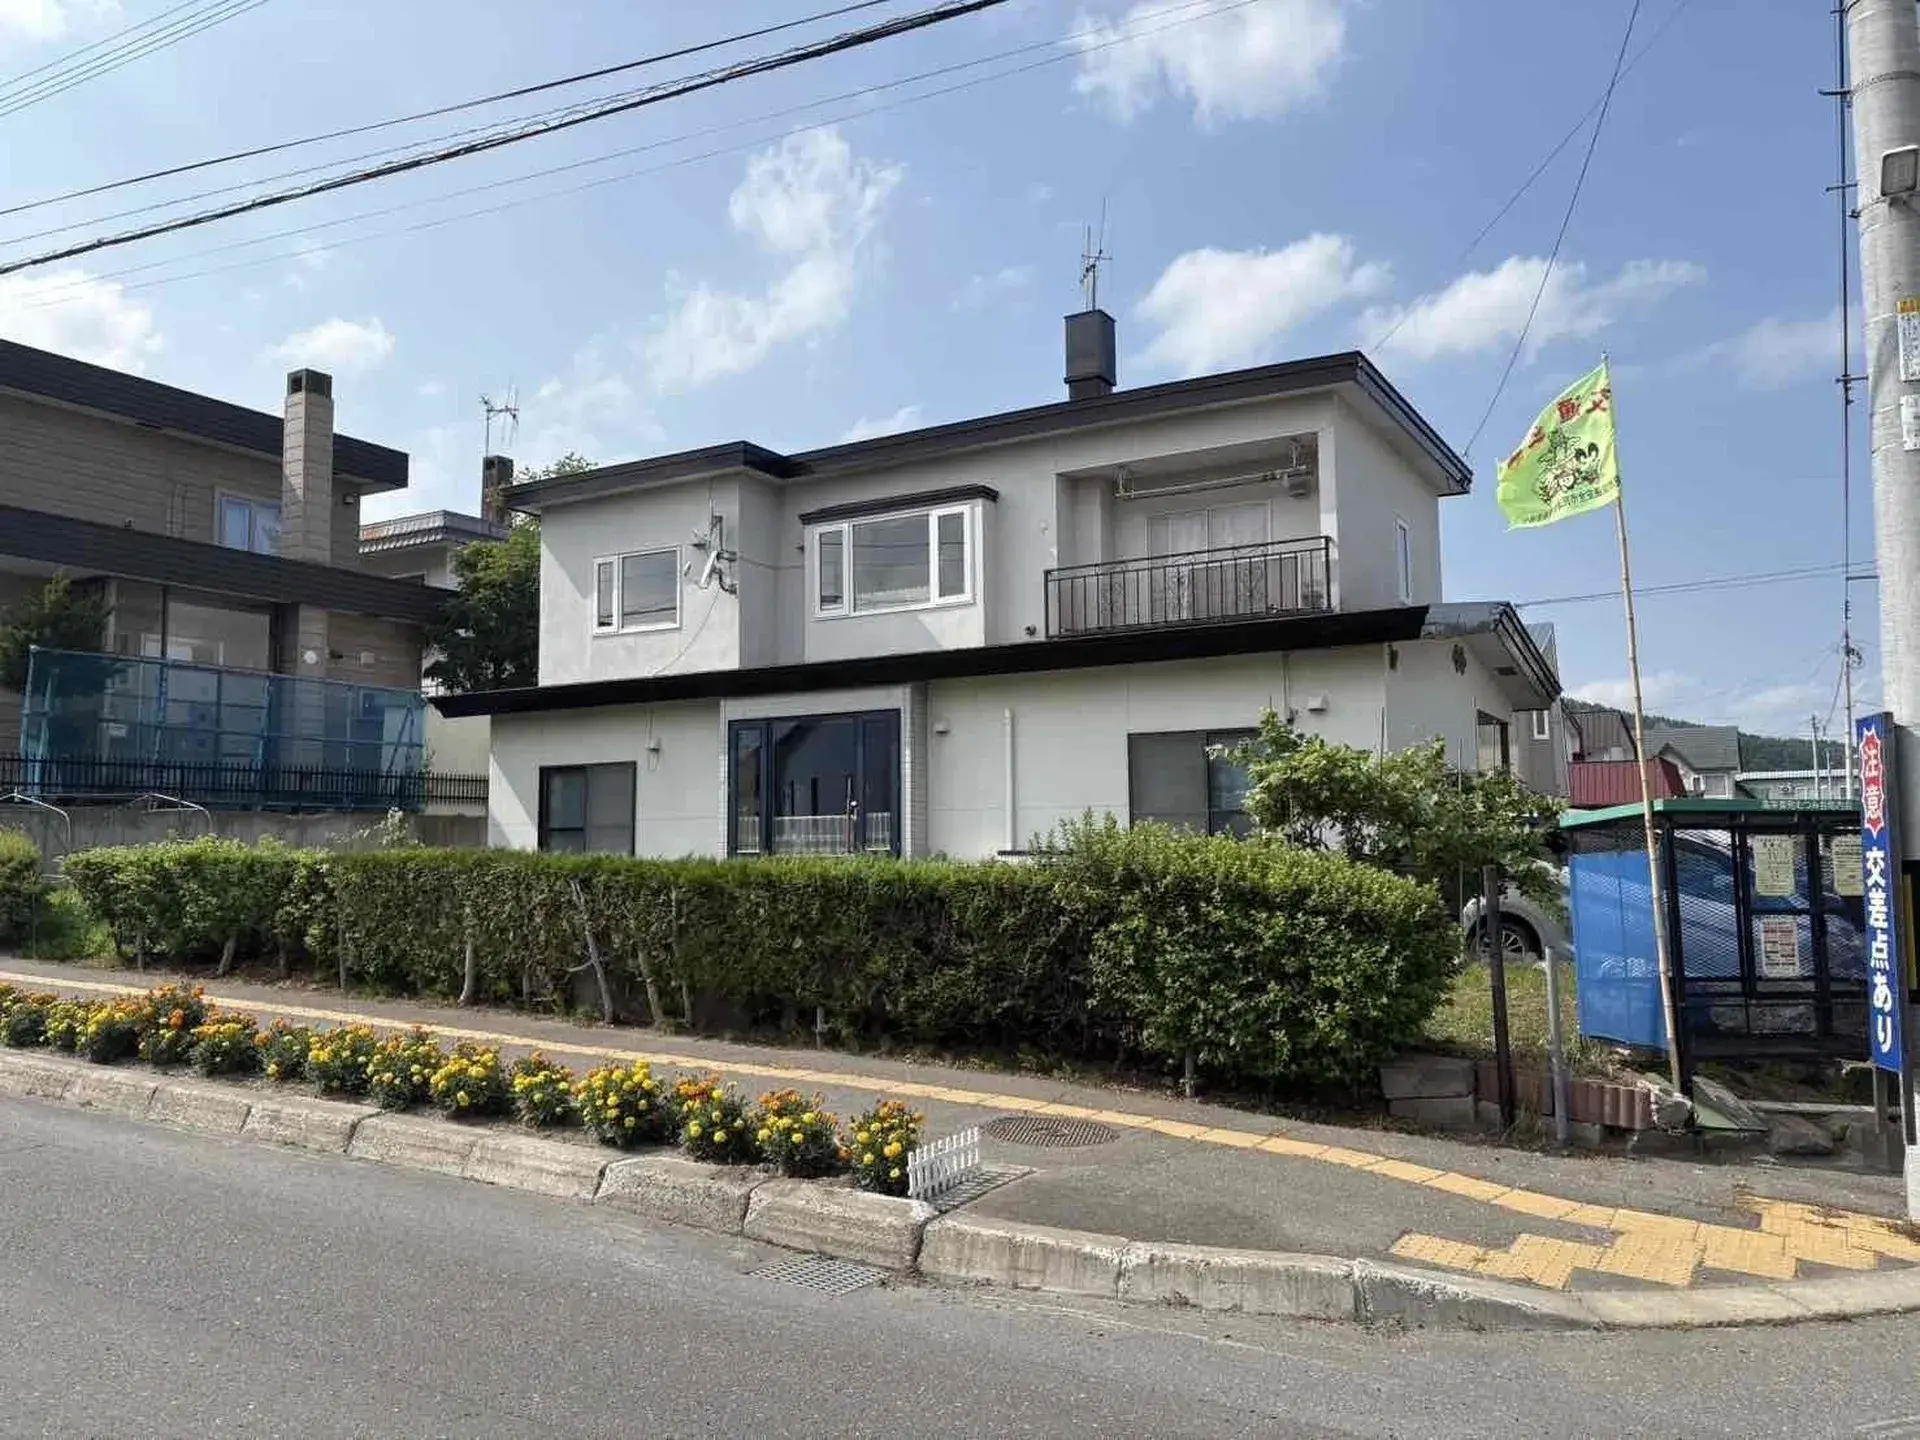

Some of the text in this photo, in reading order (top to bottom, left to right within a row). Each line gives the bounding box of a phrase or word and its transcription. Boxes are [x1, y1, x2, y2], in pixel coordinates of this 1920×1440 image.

[1864, 741, 1880, 819] 注意
[1865, 846, 1892, 1053] 交差点あり
